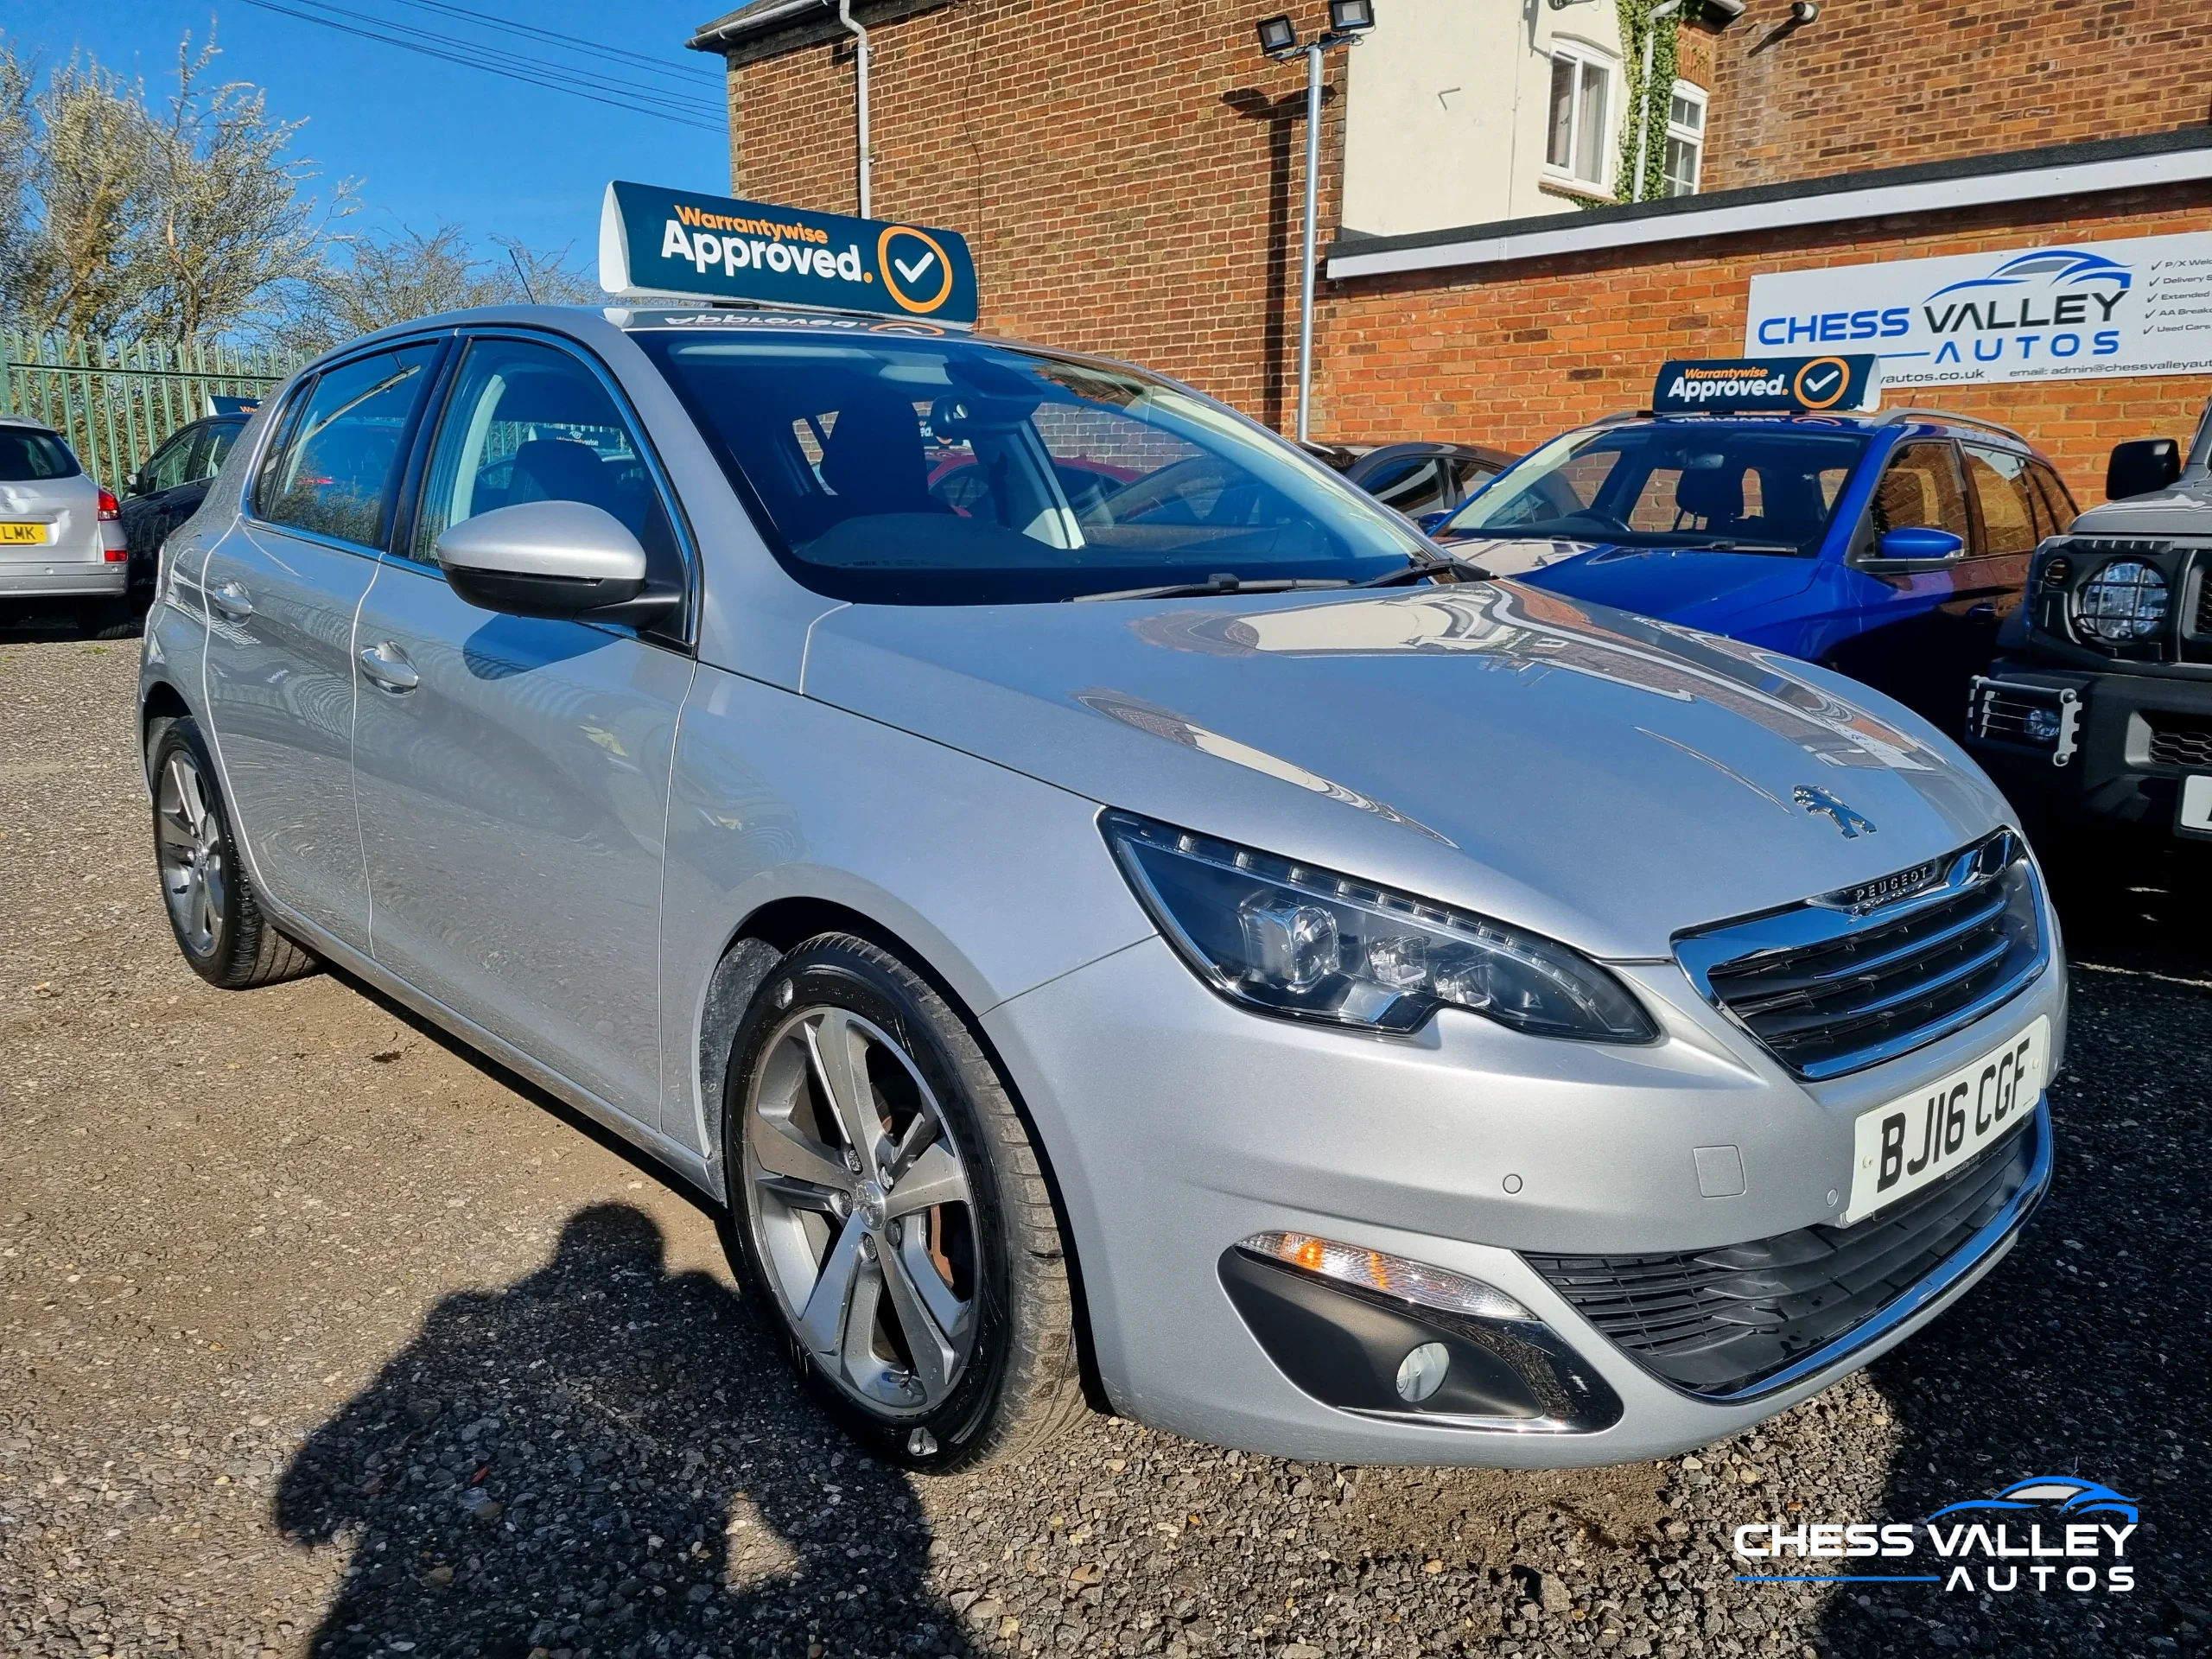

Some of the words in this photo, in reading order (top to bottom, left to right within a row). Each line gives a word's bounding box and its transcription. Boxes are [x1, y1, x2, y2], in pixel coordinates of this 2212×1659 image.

[673, 205, 829, 245] Warrantywise
[661, 219, 874, 284] Approved.
[2164, 260, 2186, 269] P/X
[2161, 291, 2210, 300] Extended
[1758, 307, 1910, 346] CHESS
[1923, 289, 2131, 334] VALLEY
[1935, 330, 2120, 365] AUTOS
[1668, 373, 1789, 403] Approved.
[1684, 366, 1769, 379] Warrantywise
[2009, 368, 2048, 378] email:
[2, 526, 36, 540] LMK
[1855, 867, 1927, 901] PEUGEOT
[1877, 1082, 1969, 1194] BJ16
[1975, 1037, 2031, 1138] CGF
